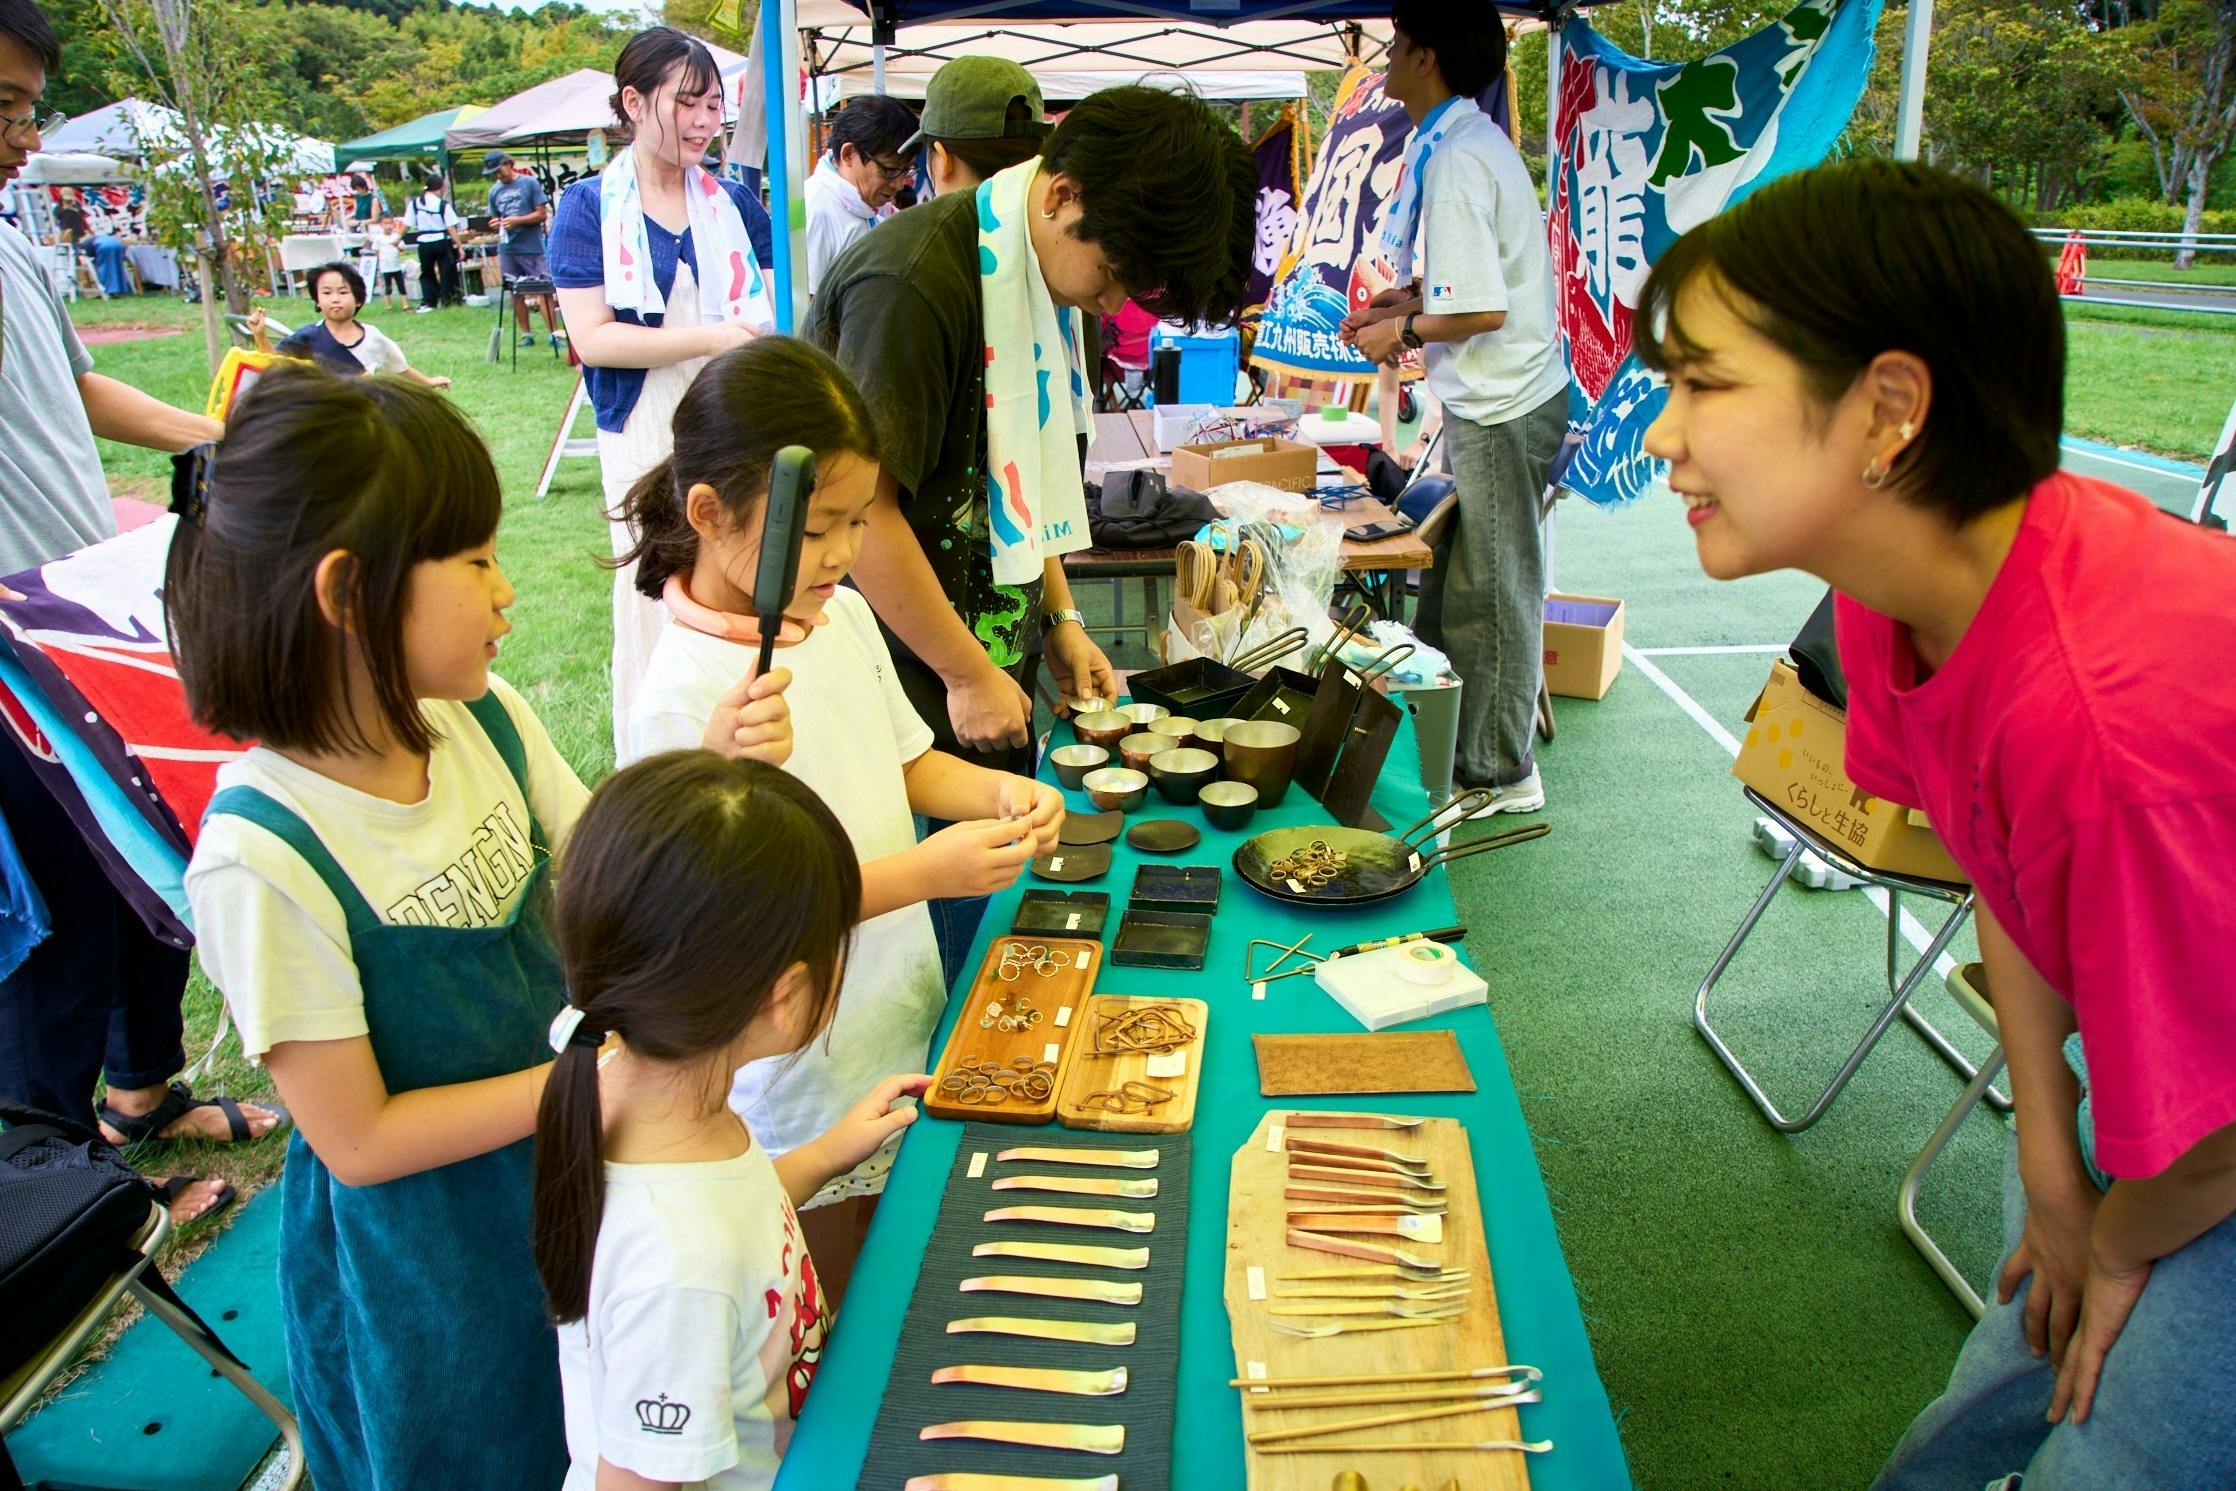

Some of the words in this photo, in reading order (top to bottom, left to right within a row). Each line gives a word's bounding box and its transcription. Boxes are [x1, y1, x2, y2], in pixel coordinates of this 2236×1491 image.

[1787, 782, 1869, 848] くらしと生協
